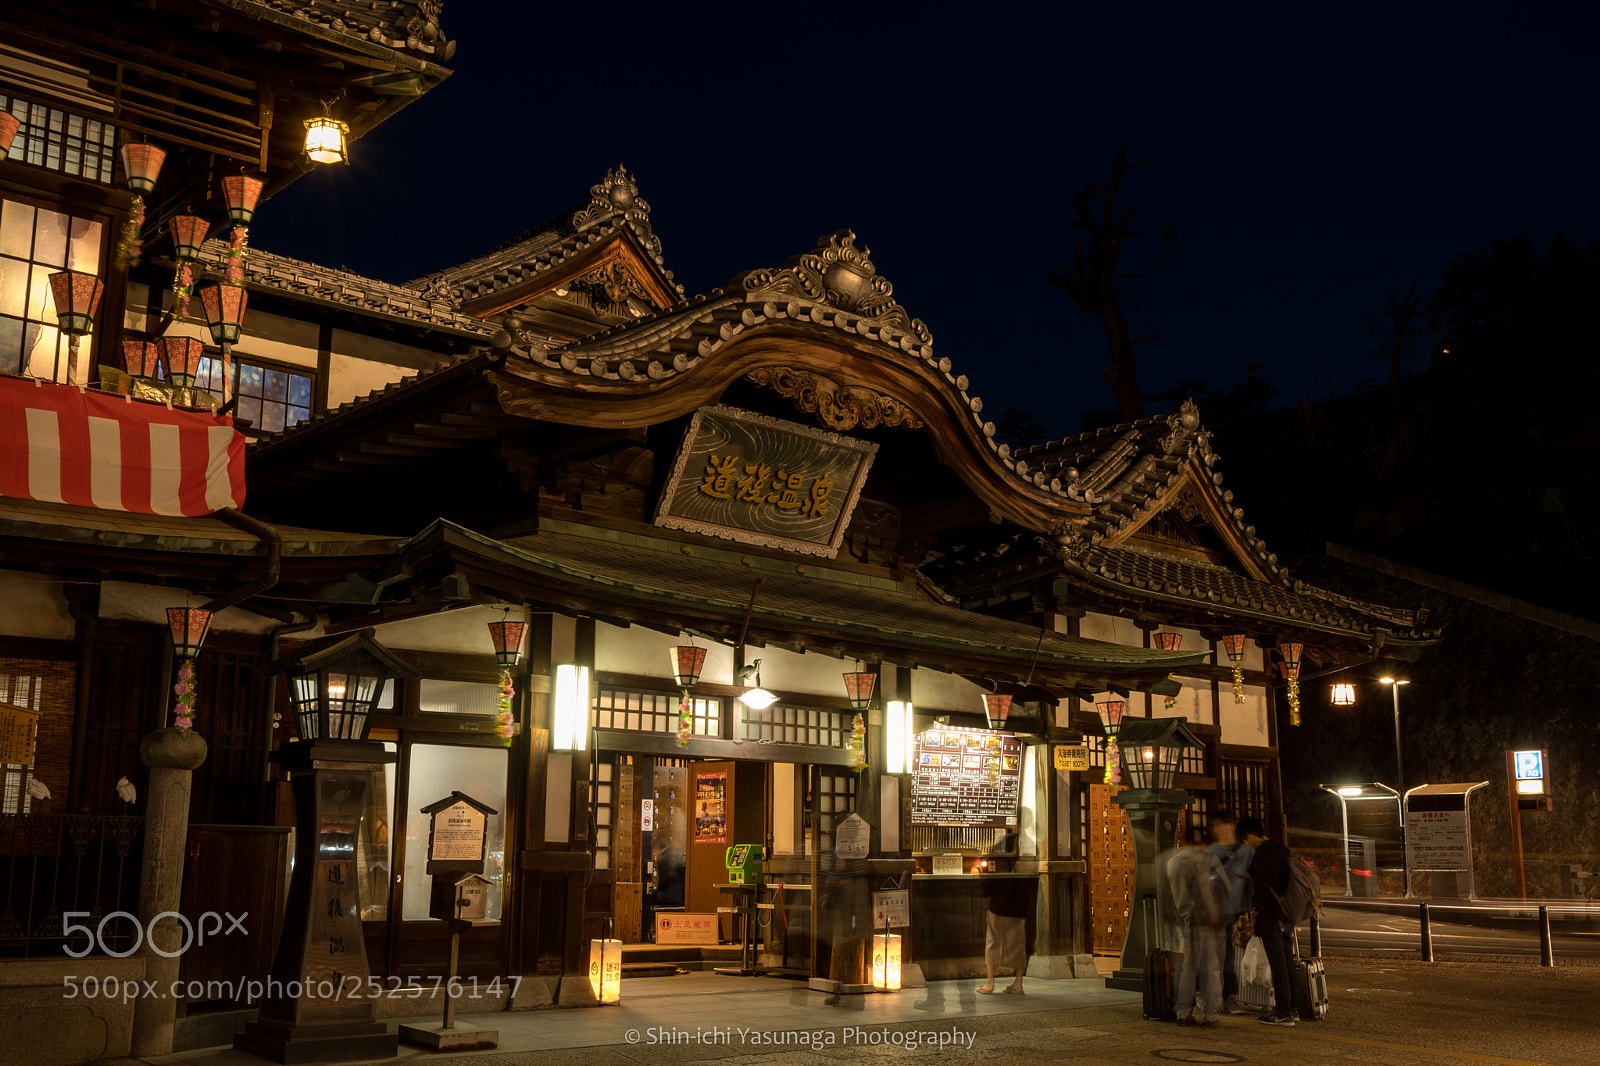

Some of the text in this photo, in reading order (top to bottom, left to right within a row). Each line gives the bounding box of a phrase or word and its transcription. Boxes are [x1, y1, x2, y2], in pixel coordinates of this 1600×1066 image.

[701, 455, 834, 516] 道後温泉
[1518, 753, 1538, 778] P
[328, 864, 346, 991] 道後温泉
